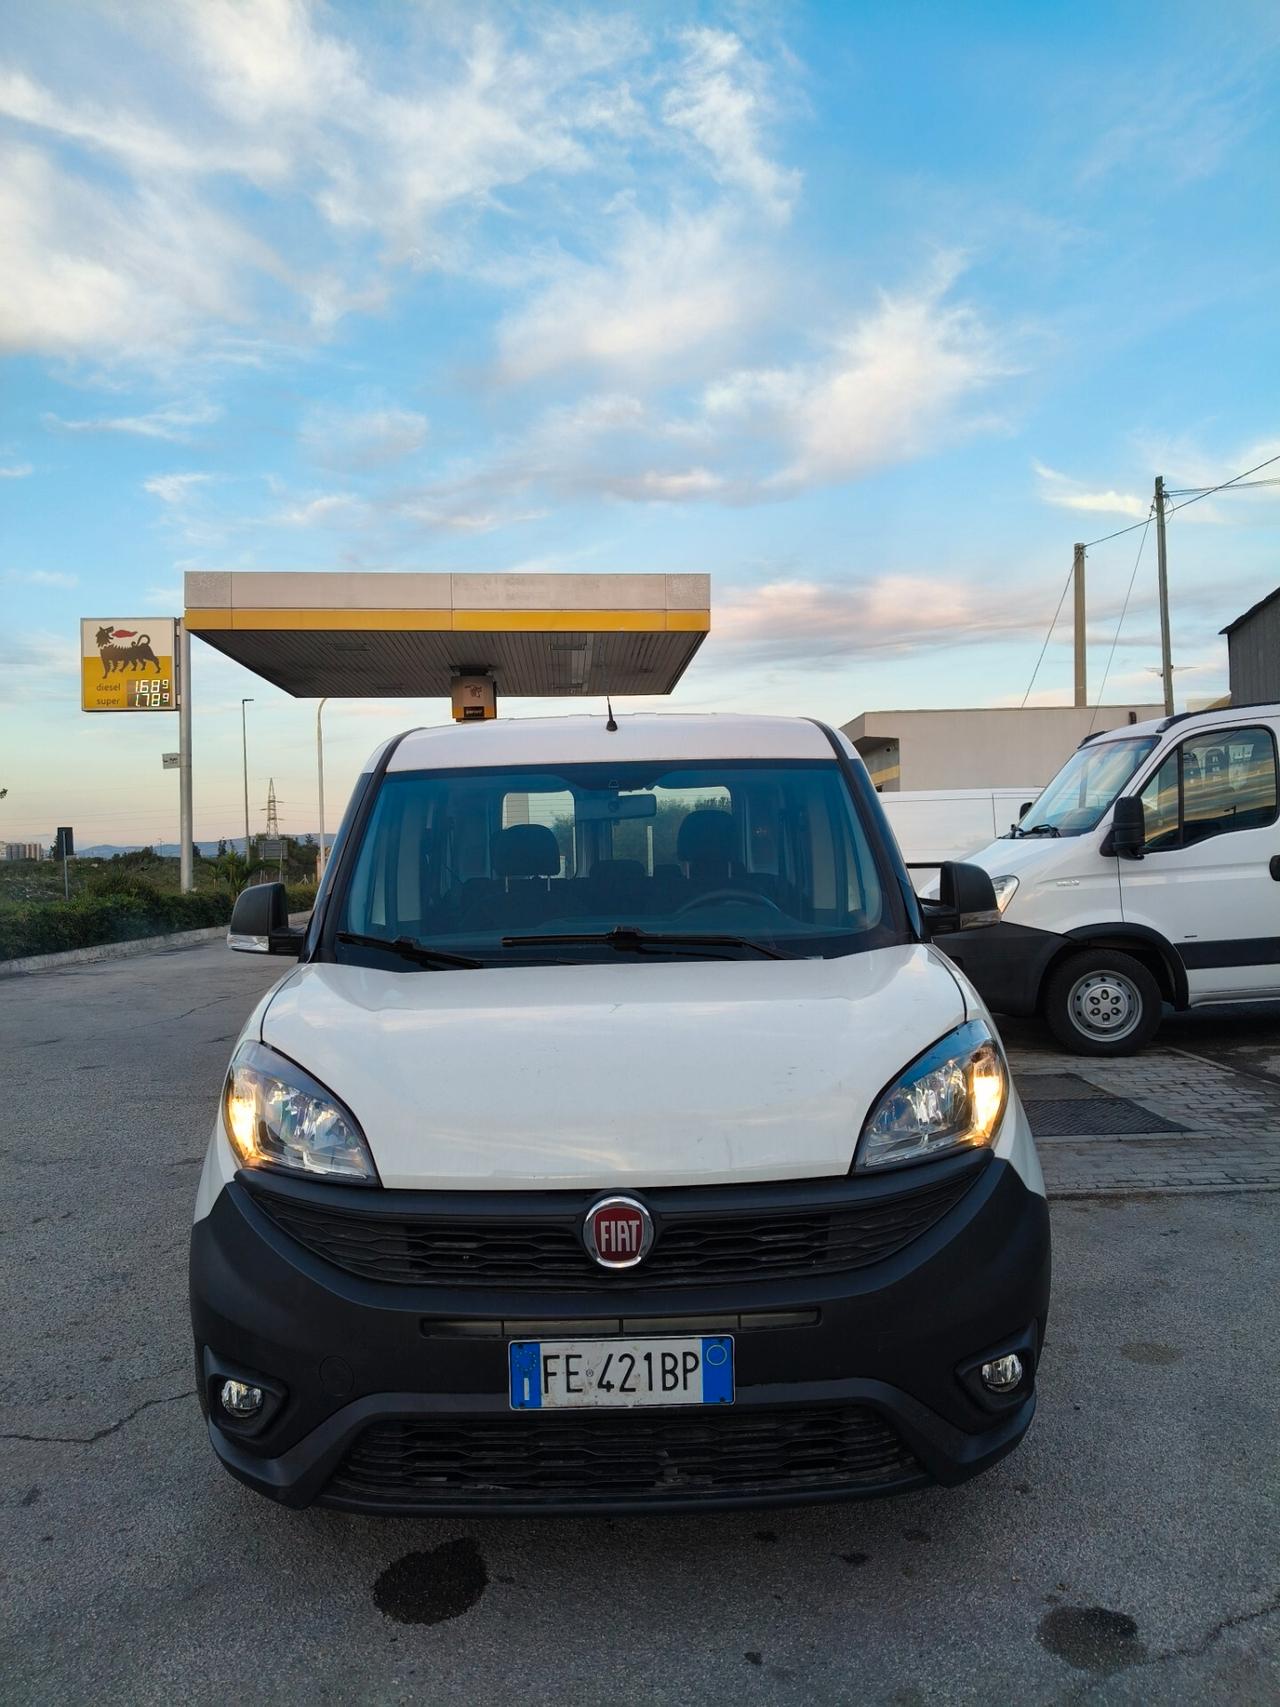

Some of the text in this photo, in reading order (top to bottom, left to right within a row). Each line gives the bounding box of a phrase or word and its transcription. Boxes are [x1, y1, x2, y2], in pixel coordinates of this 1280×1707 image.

[96, 683, 121, 691] diesel
[96, 698, 119, 706] super
[600, 1220, 640, 1252] FIAT
